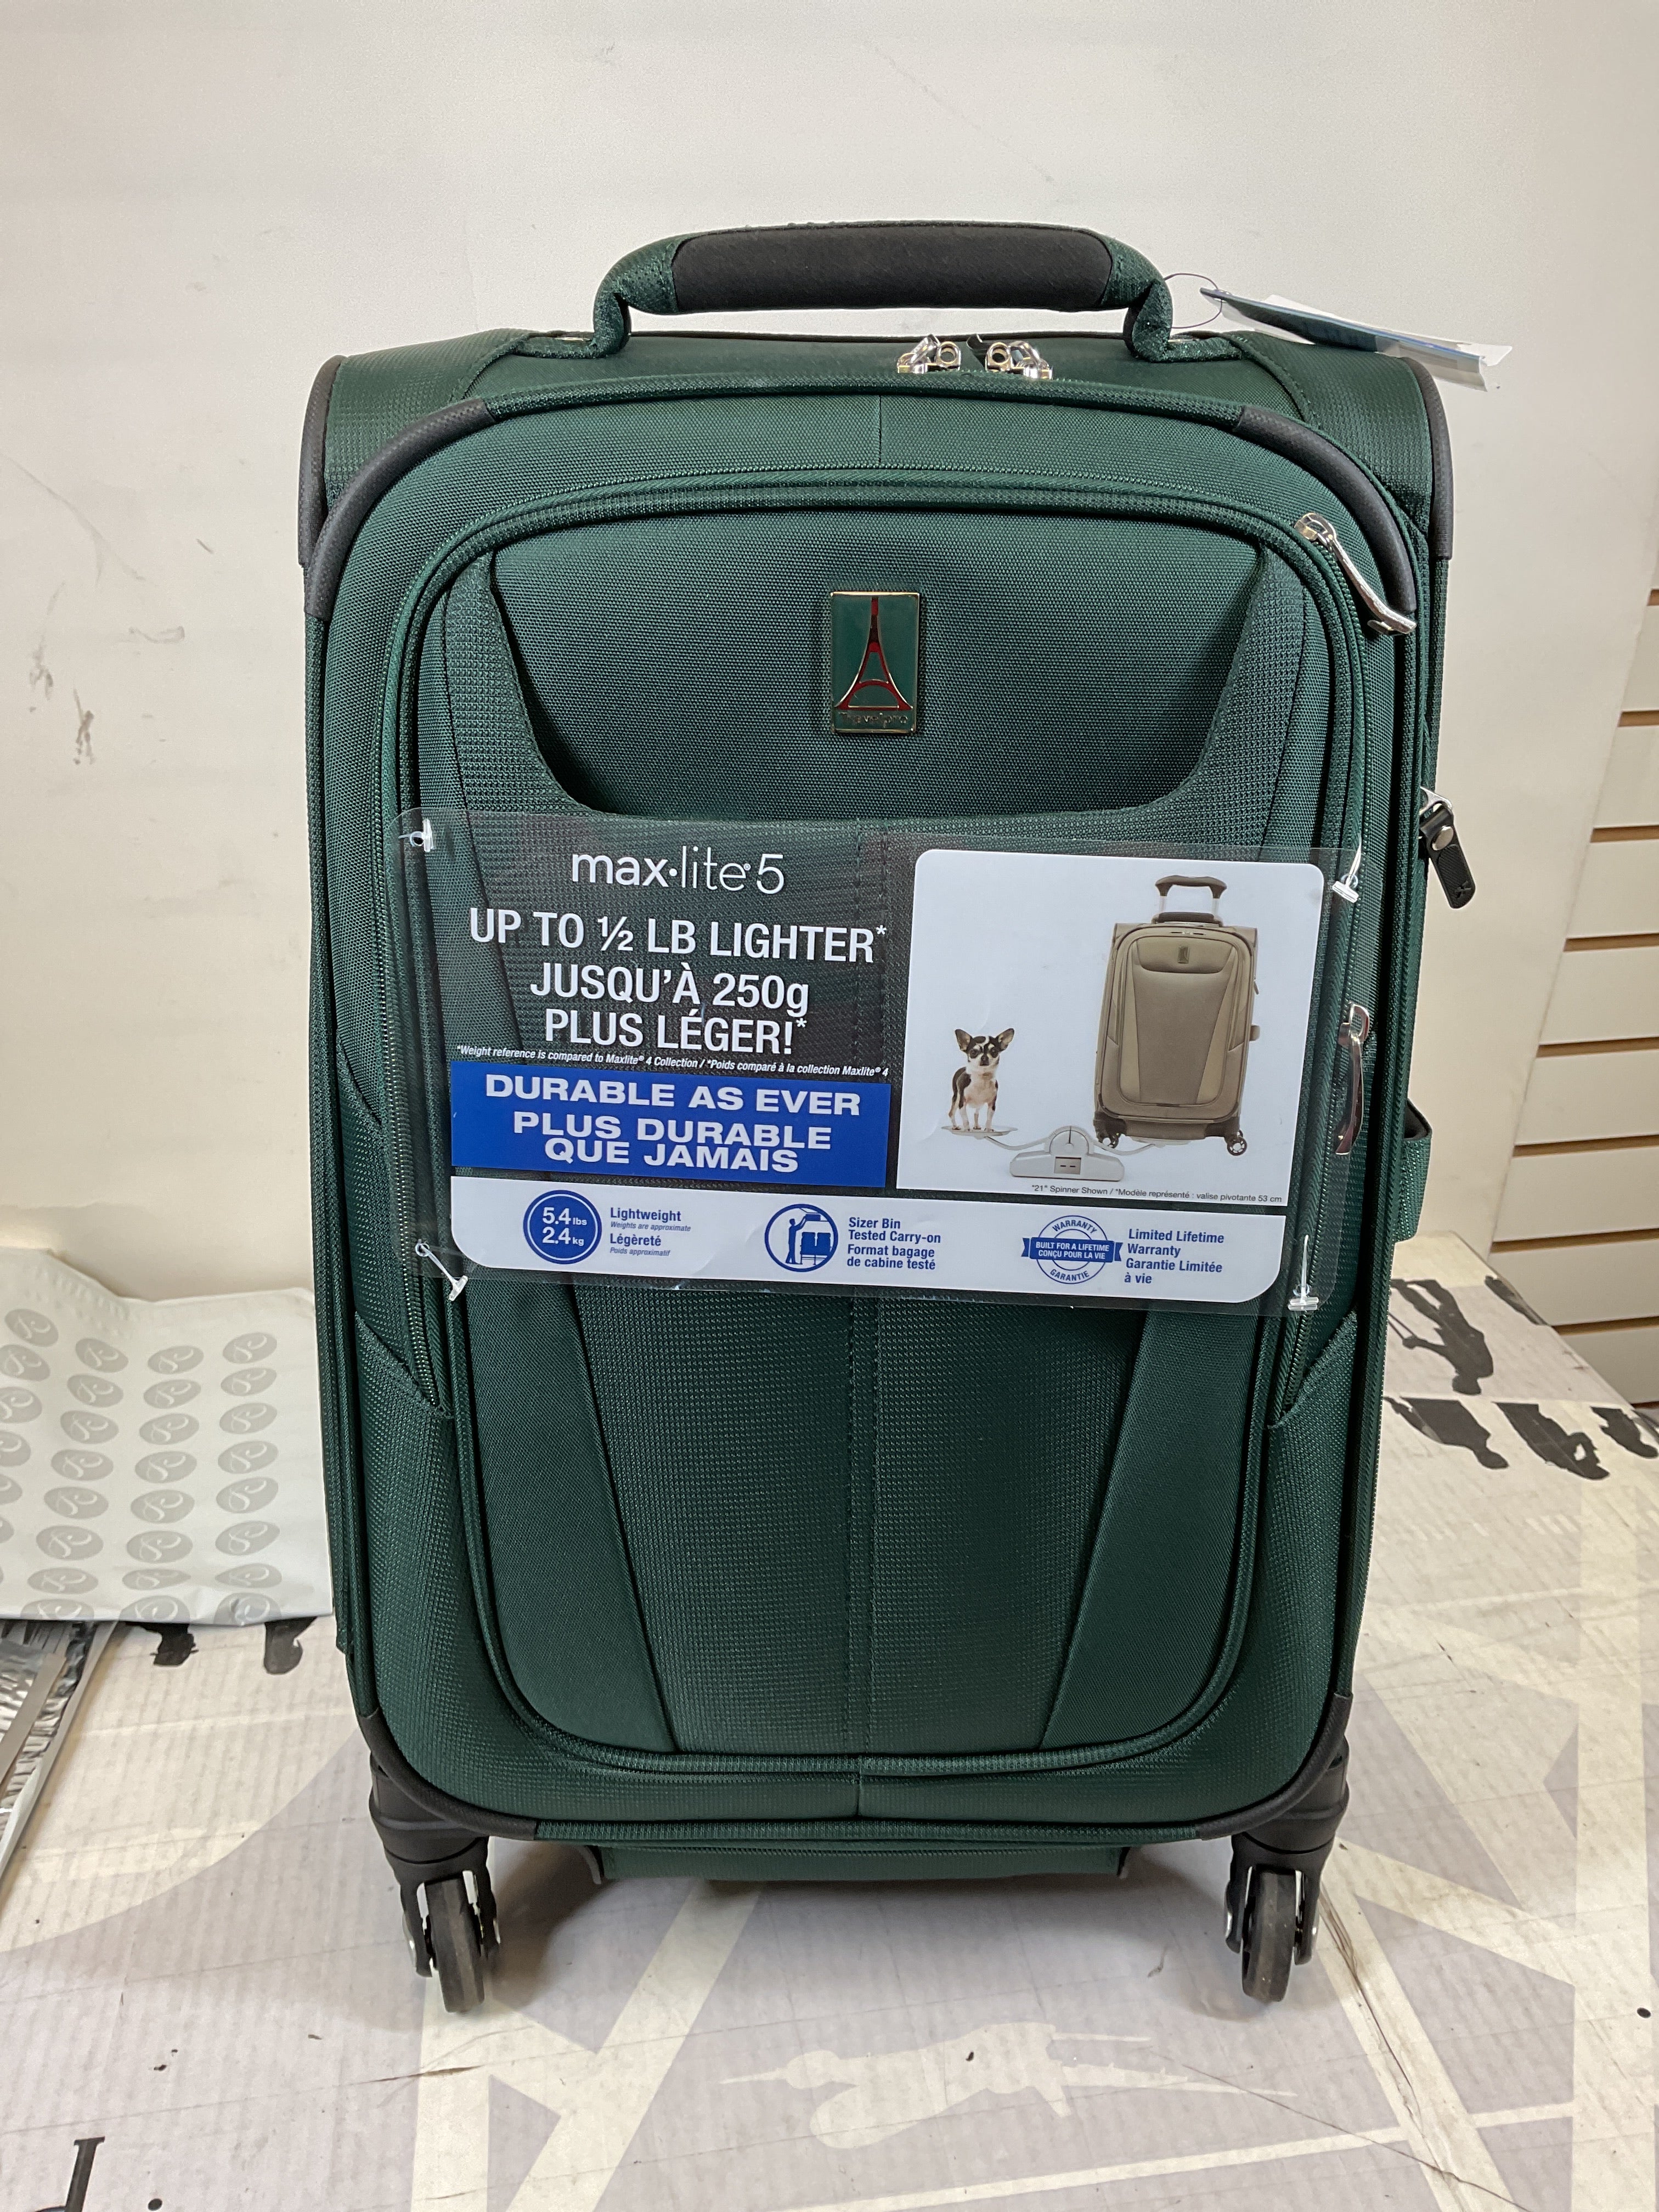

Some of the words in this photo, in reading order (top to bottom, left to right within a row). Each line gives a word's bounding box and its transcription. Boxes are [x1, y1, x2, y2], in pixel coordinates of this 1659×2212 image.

[756, 853, 785, 895] 5
[470, 907, 522, 944] UP
[533, 912, 584, 949] TO
[648, 918, 696, 955] LB
[712, 973, 809, 1017] 250g
[545, 1008, 643, 1047] PLUS
[493, 1048, 535, 1059] reference
[537, 1050, 546, 1059] is
[548, 1052, 592, 1064] compared
[595, 1053, 603, 1063] to
[646, 1057, 652, 1065] 4
[653, 1057, 698, 1068] Collection
[737, 1062, 776, 1074] comparé
[778, 1062, 784, 1072] à
[786, 1063, 794, 1073] la
[797, 1064, 840, 1075] collection
[882, 1068, 888, 1077] 4
[486, 1074, 675, 1108] DURABLE
[689, 1086, 744, 1111] AS
[756, 1088, 861, 1116] EVER
[514, 1111, 622, 1139] PLUS
[637, 1118, 832, 1150] DURABLE
[544, 1137, 630, 1165] QUE
[644, 1144, 798, 1173] JAMAIS
[1049, 1185, 1080, 1194] Spinner
[1149, 1190, 1189, 1199] représenté
[1220, 1193, 1256, 1201] pivotante
[543, 1207, 571, 1224] 5.4
[572, 1217, 587, 1226] lbs
[610, 1207, 681, 1223] Lightweight
[849, 1217, 878, 1228] Sizer
[882, 1218, 900, 1229] Bin
[611, 1221, 636, 1229] Weights
[1052, 1220, 1097, 1234] WARRANTY
[542, 1226, 571, 1244] 2.4
[572, 1237, 584, 1246] kg
[610, 1233, 662, 1247] Légèreté
[848, 1229, 886, 1241] Tested
[890, 1231, 941, 1244] Carry-on
[1128, 1228, 1173, 1241] Limited
[1176, 1231, 1224, 1243] Lifetime
[848, 1244, 889, 1255] Format
[892, 1245, 935, 1259] bagage
[1039, 1249, 1062, 1259] CONÇU
[1127, 1243, 1181, 1258] Warranty
[847, 1256, 861, 1267] de
[865, 1257, 903, 1268] cabine
[907, 1259, 935, 1270] testé
[1126, 1257, 1176, 1271] Garantie
[1179, 1260, 1222, 1273] Limitée
[1049, 1268, 1090, 1281] GARANTIE
[1124, 1272, 1131, 1283] à
[1135, 1273, 1152, 1284] vie
